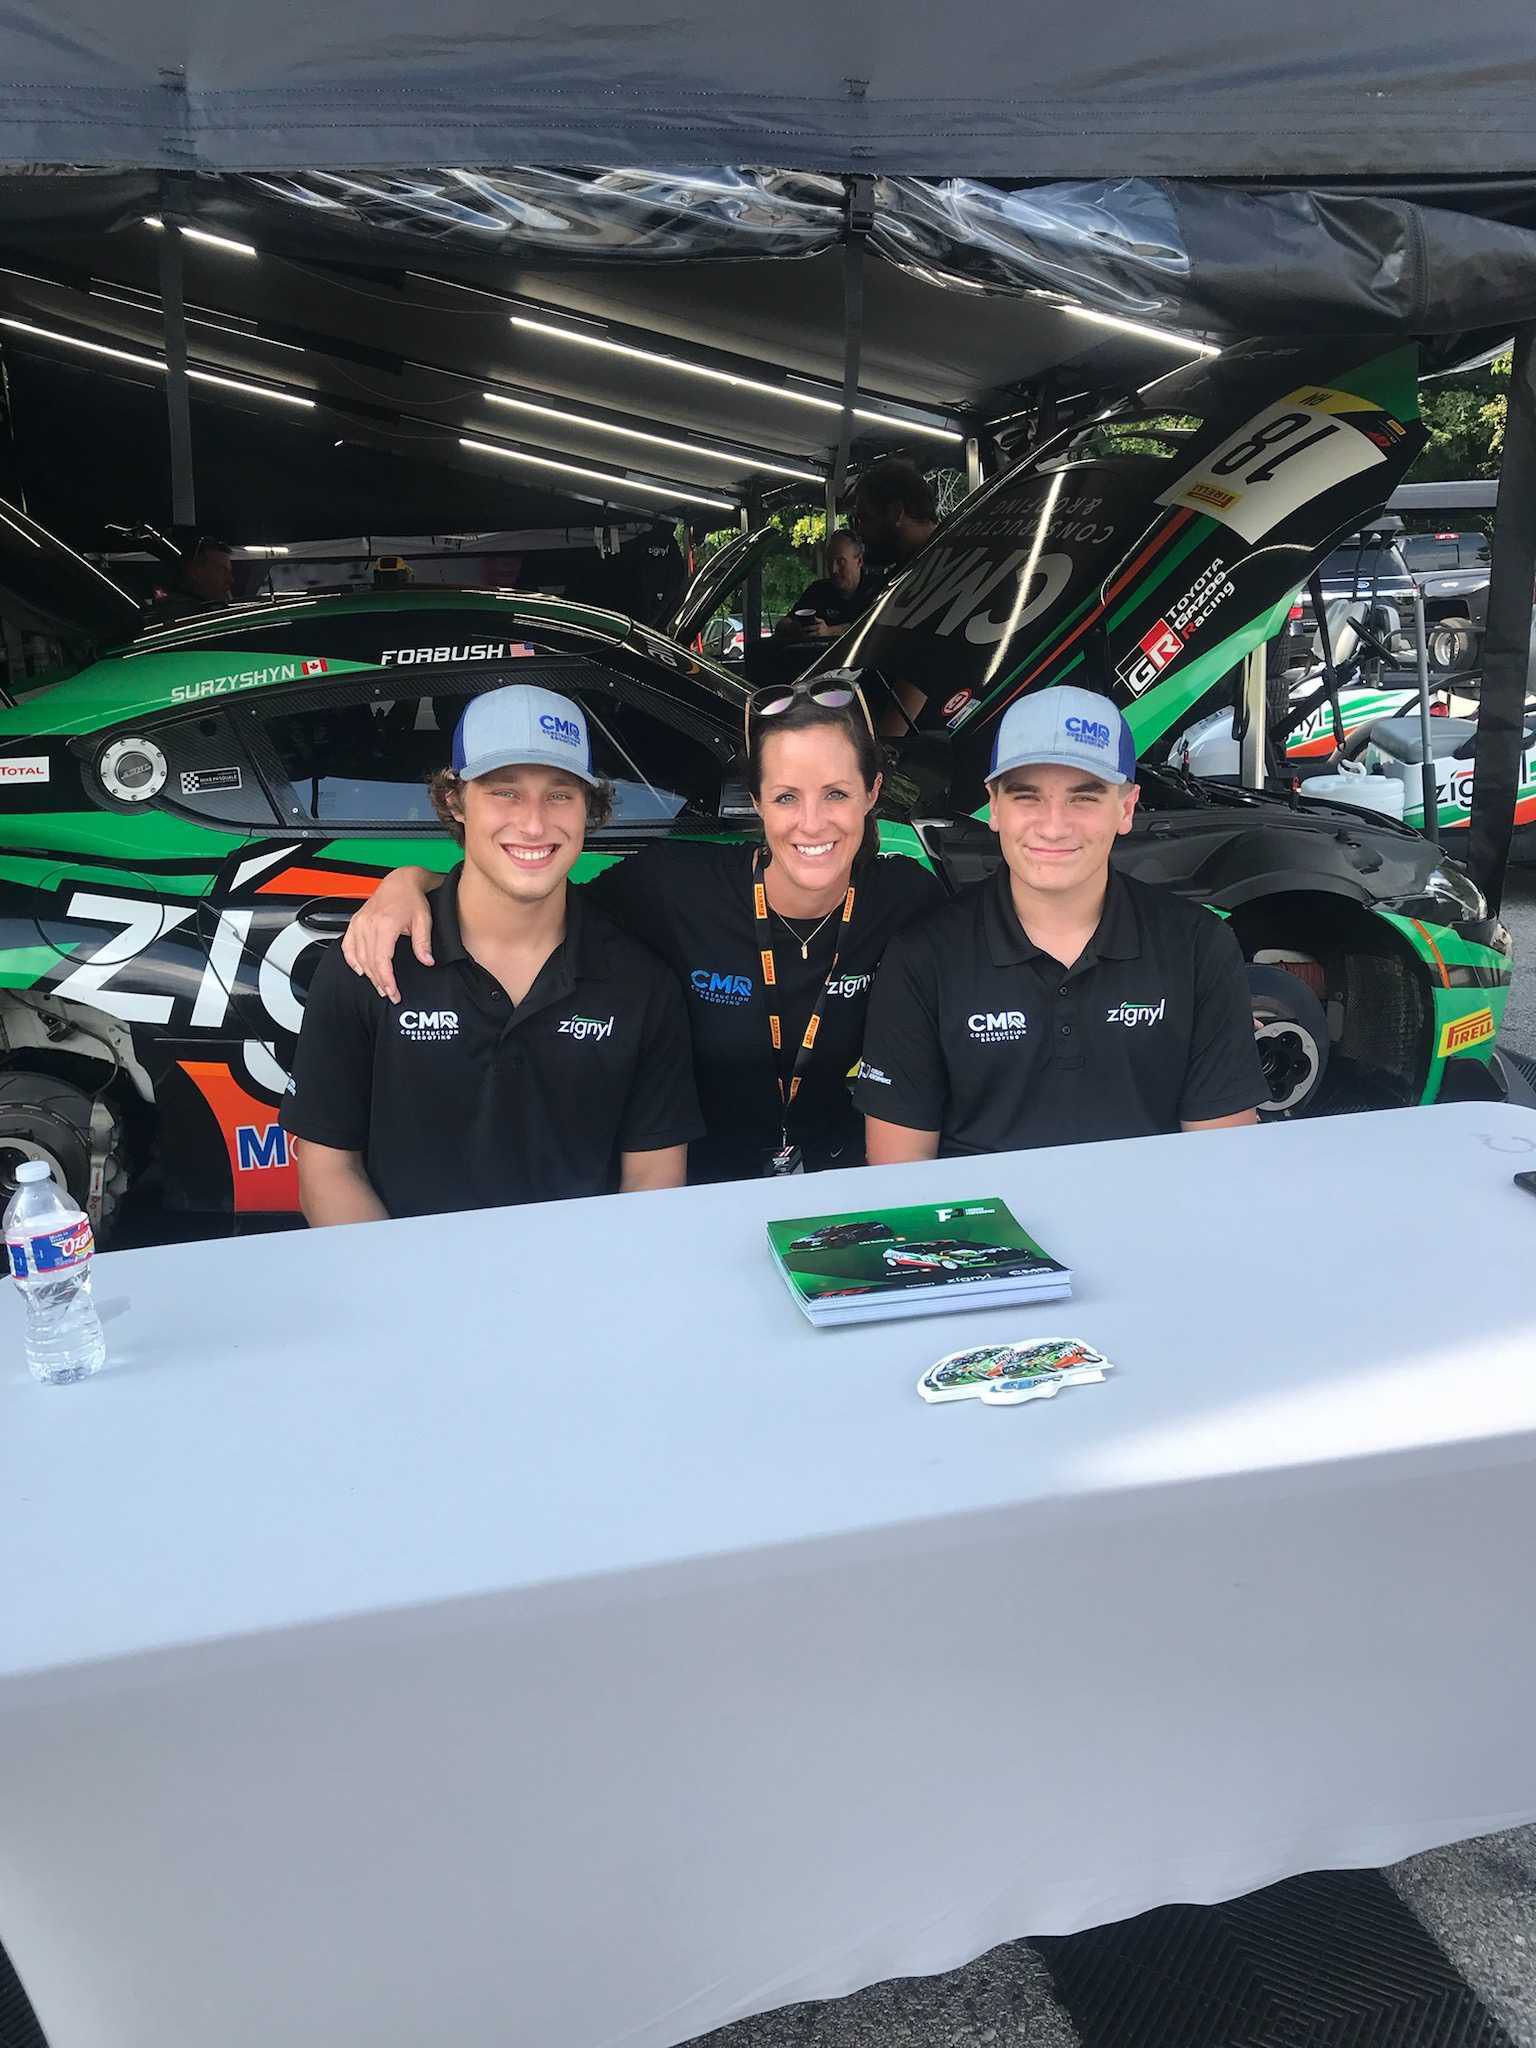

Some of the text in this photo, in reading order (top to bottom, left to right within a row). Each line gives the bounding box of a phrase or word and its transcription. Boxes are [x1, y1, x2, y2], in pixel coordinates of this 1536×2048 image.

[1211, 412, 1342, 486] 18
[1165, 558, 1224, 619] TOYOTA
[1174, 571, 1227, 630] GAZOO
[1181, 581, 1236, 640] Racing
[381, 643, 504, 666] FORBUSH
[1128, 631, 1181, 692] GR
[171, 663, 296, 703] SURZYSHYN
[1, 766, 45, 777] TOTAL
[690, 969, 753, 997] CMR
[399, 1010, 459, 1030] CMR
[557, 1013, 615, 1041] zignyl
[968, 1011, 1027, 1032] CMR
[1106, 998, 1166, 1027] zignyl
